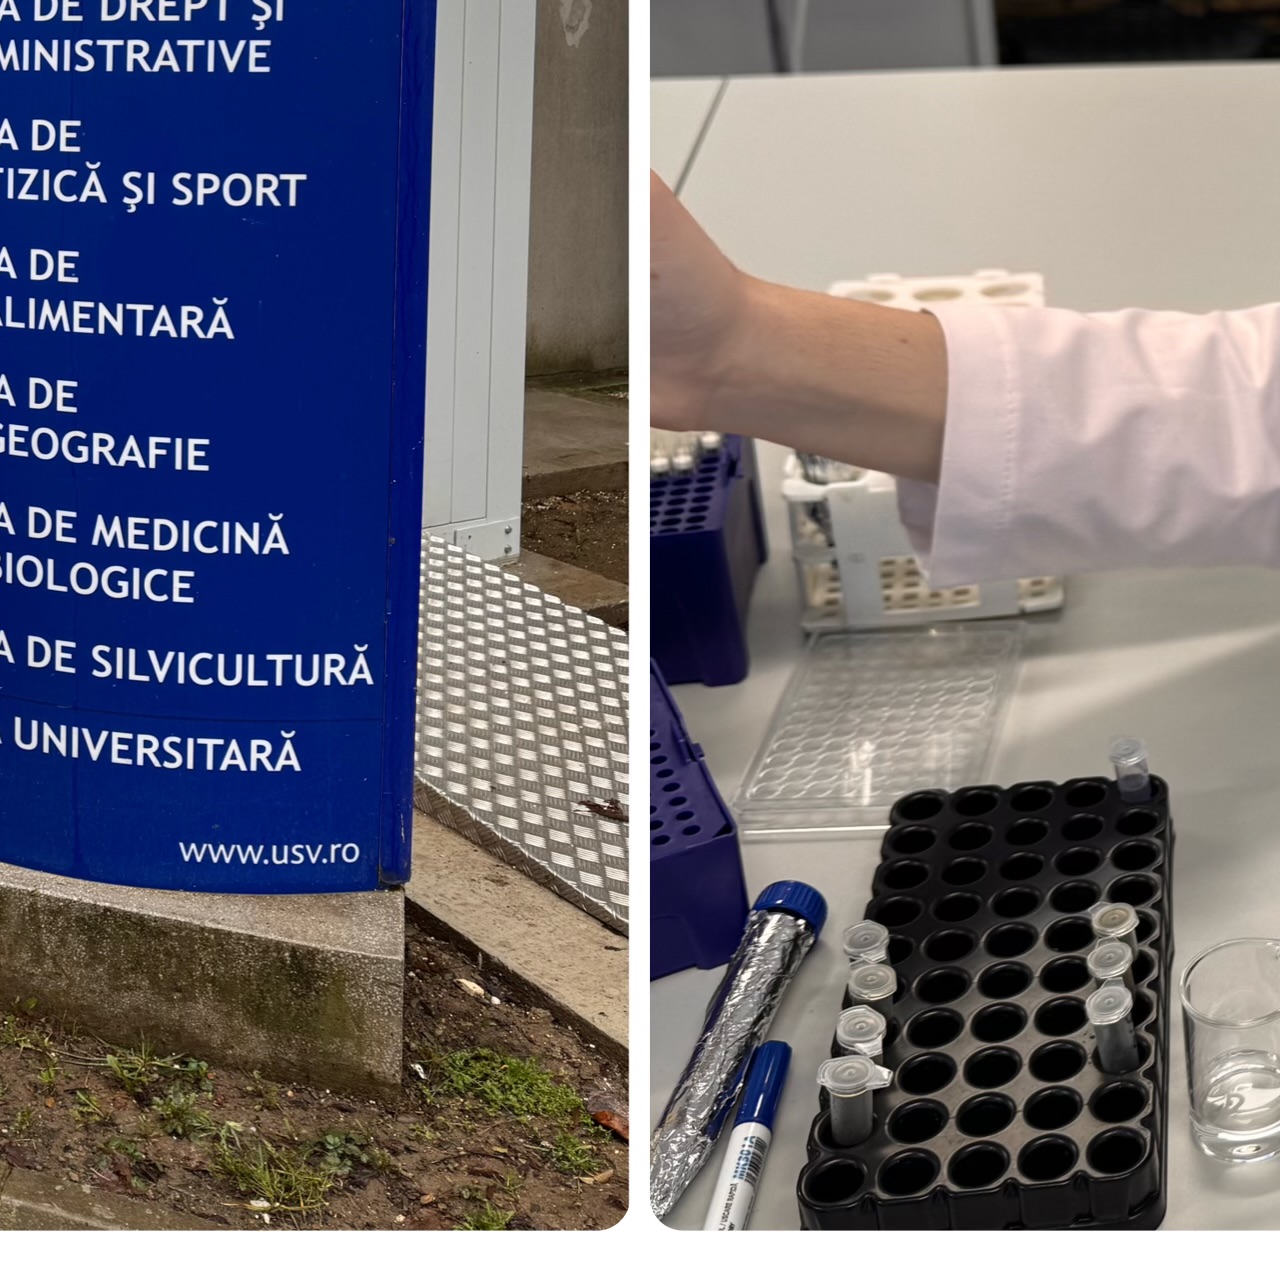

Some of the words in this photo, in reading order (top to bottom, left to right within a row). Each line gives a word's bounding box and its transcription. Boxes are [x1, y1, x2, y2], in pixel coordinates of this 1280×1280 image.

[32, 120, 81, 152] DE
[173, 173, 306, 206] SPORT
[31, 249, 79, 282] DE
[29, 378, 77, 412] DE
[29, 507, 76, 543] DE
[92, 513, 289, 554] MEDICINĂ
[28, 636, 76, 673] DE
[92, 644, 373, 686] SILVICULTURĂ
[15, 717, 301, 771] UNIVERSITARĂ
[179, 842, 359, 864] www.usv.ro
